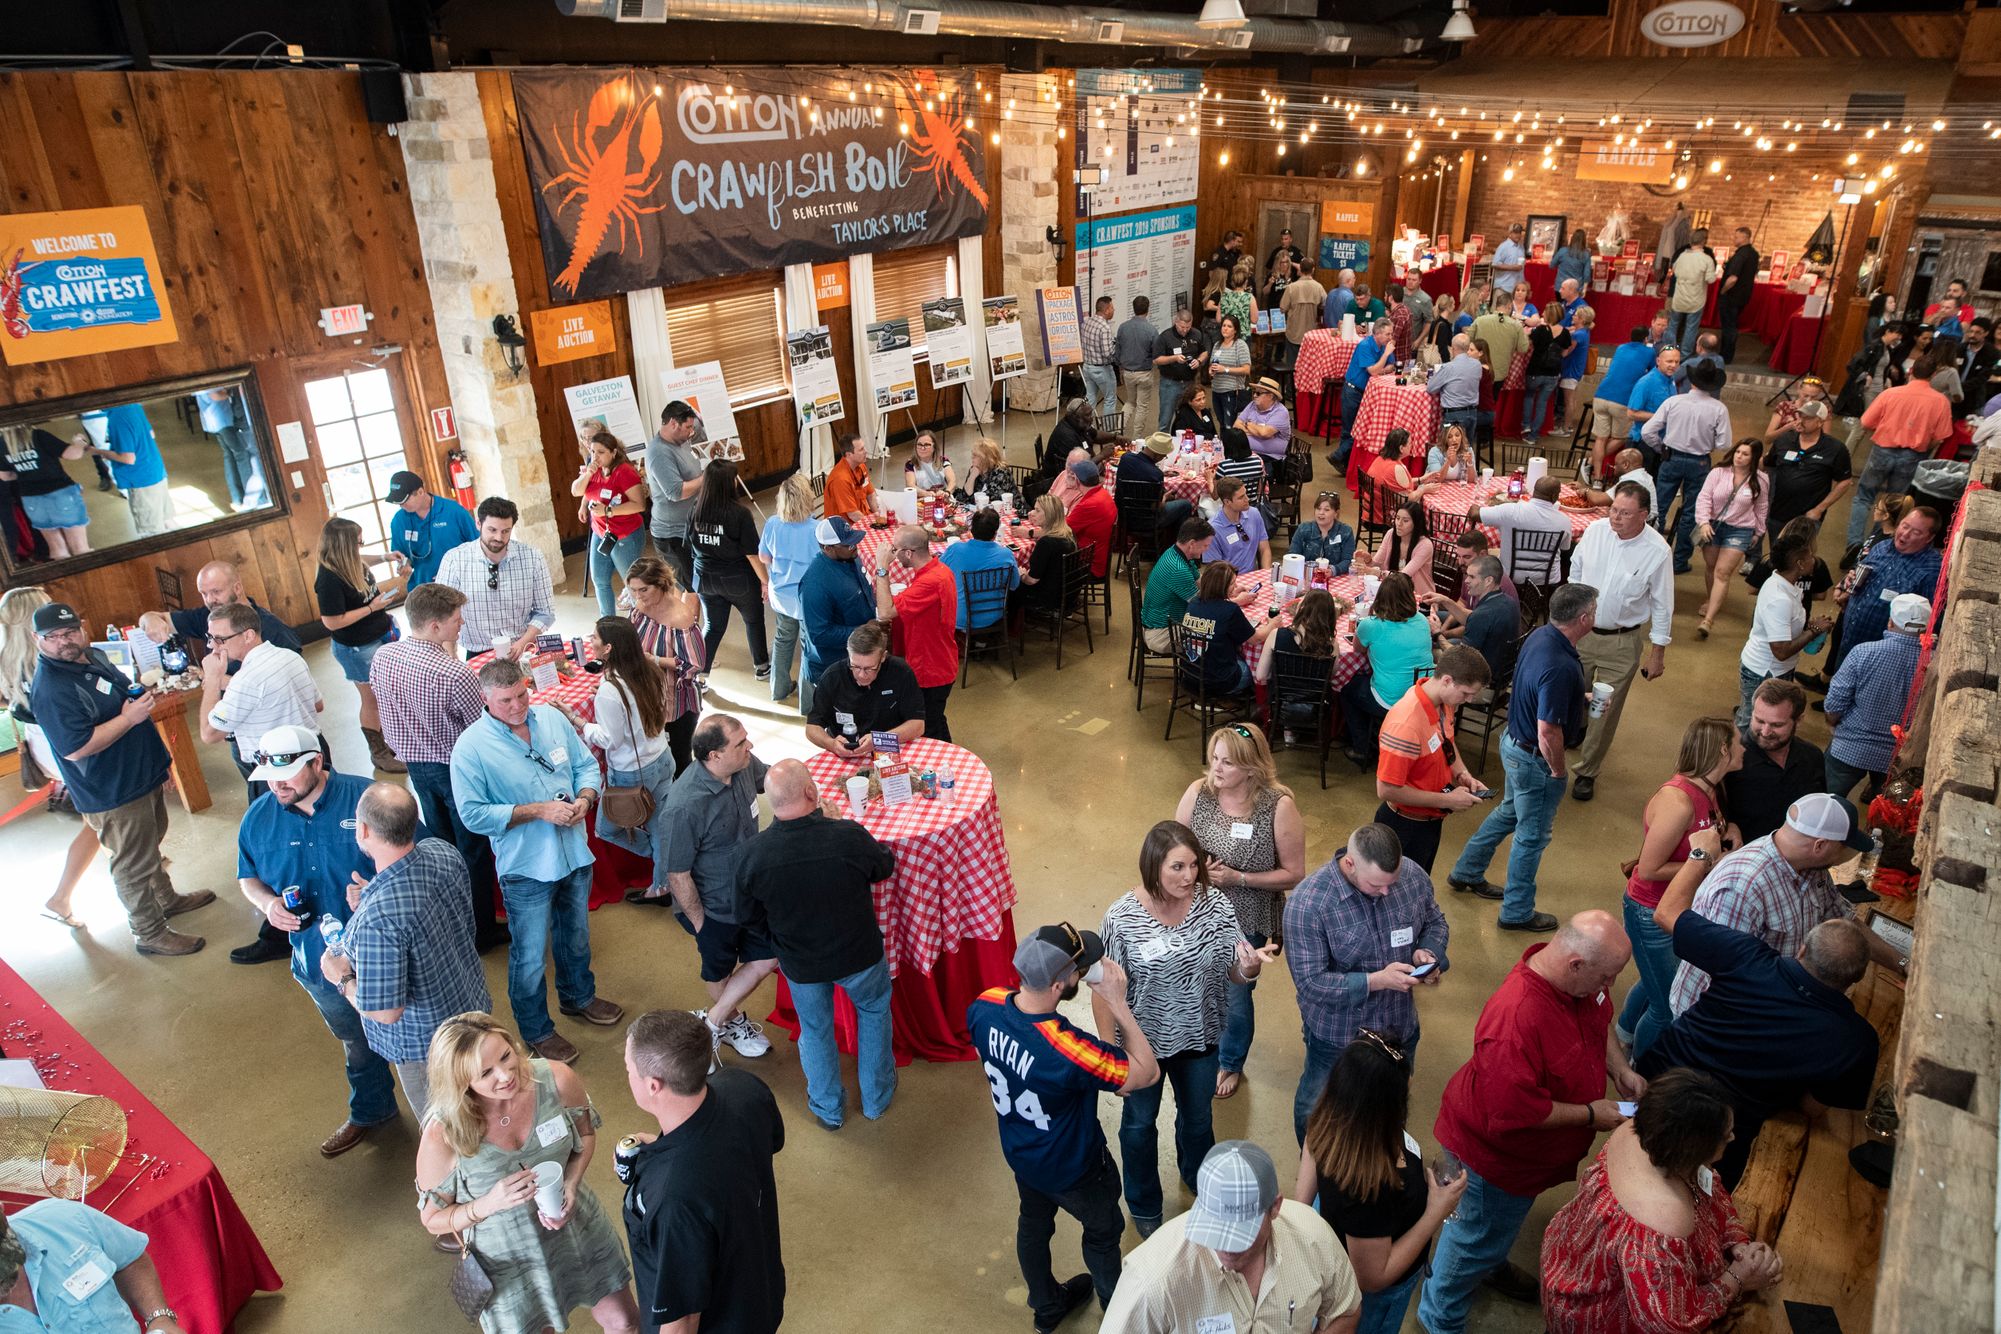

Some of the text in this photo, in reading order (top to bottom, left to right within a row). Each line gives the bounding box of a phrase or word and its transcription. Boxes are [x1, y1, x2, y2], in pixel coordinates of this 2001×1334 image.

[1653, 11, 1728, 36] COTTON
[677, 84, 883, 144] COTTON ANNUAL
[1596, 145, 1658, 167] RAFFLE
[792, 201, 859, 221] BENEFITTING
[1335, 213, 1359, 223] RAFFLE
[831, 210, 928, 245] TAYLOR'S PLACE
[1096, 214, 1180, 243] CRAWFEST 2019 SPONSORS
[32, 232, 117, 254] WELCOME TO
[1334, 242, 1356, 251] RAFFLE
[1333, 250, 1356, 260] TICKETS
[56, 264, 107, 281] COTTON
[821, 274, 836, 287] LIVE
[27, 274, 146, 310] CRAWFEST
[817, 285, 843, 299] AUCTION
[330, 307, 360, 331] EXIT
[563, 316, 585, 333] LIVE
[1050, 311, 1076, 322] ASTROS
[557, 330, 595, 349] AUCTION
[575, 381, 624, 399] GALVESTON
[667, 380, 684, 390] GUEST
[699, 374, 719, 384] DINNER
[582, 390, 621, 406] GETAWAY
[698, 533, 720, 546] TEAM
[989, 1026, 1035, 1080] RYAN
[984, 1060, 1052, 1131] 34
